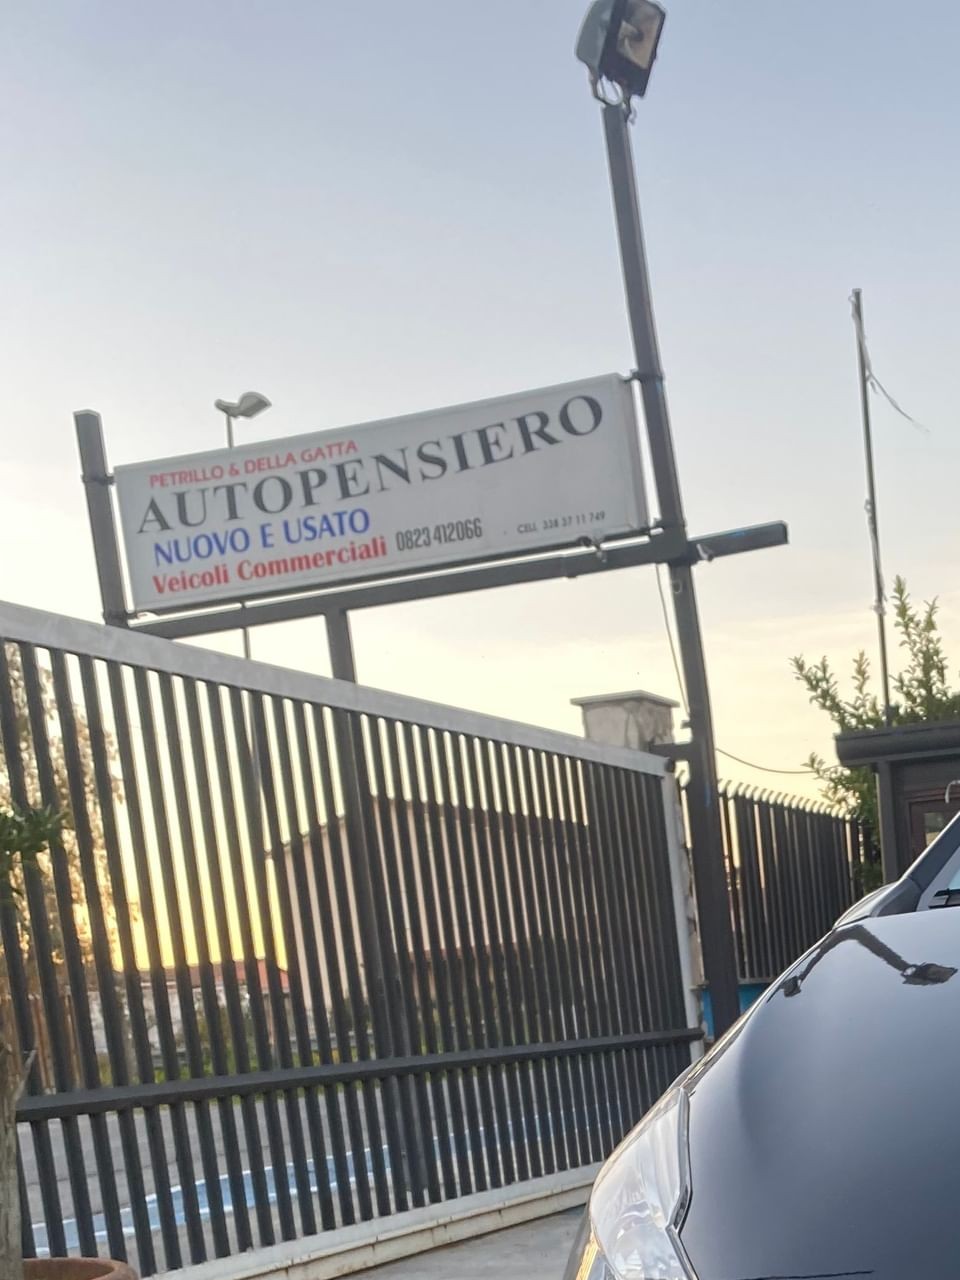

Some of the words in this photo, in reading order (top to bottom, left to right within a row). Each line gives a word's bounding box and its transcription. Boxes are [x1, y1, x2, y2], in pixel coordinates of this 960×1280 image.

[137, 394, 604, 534] AUTOPENSIERO
[149, 465, 224, 488] PETRILLO
[228, 463, 241, 478] &
[244, 452, 297, 475] DELLA
[300, 439, 359, 463] GATTA
[153, 527, 250, 568] NUOVO
[260, 523, 275, 548] E
[283, 508, 371, 544] USATO
[516, 521, 537, 534] CELL
[562, 515, 573, 528] 37
[152, 564, 230, 594] Veicoli
[236, 536, 388, 582] Commerciali
